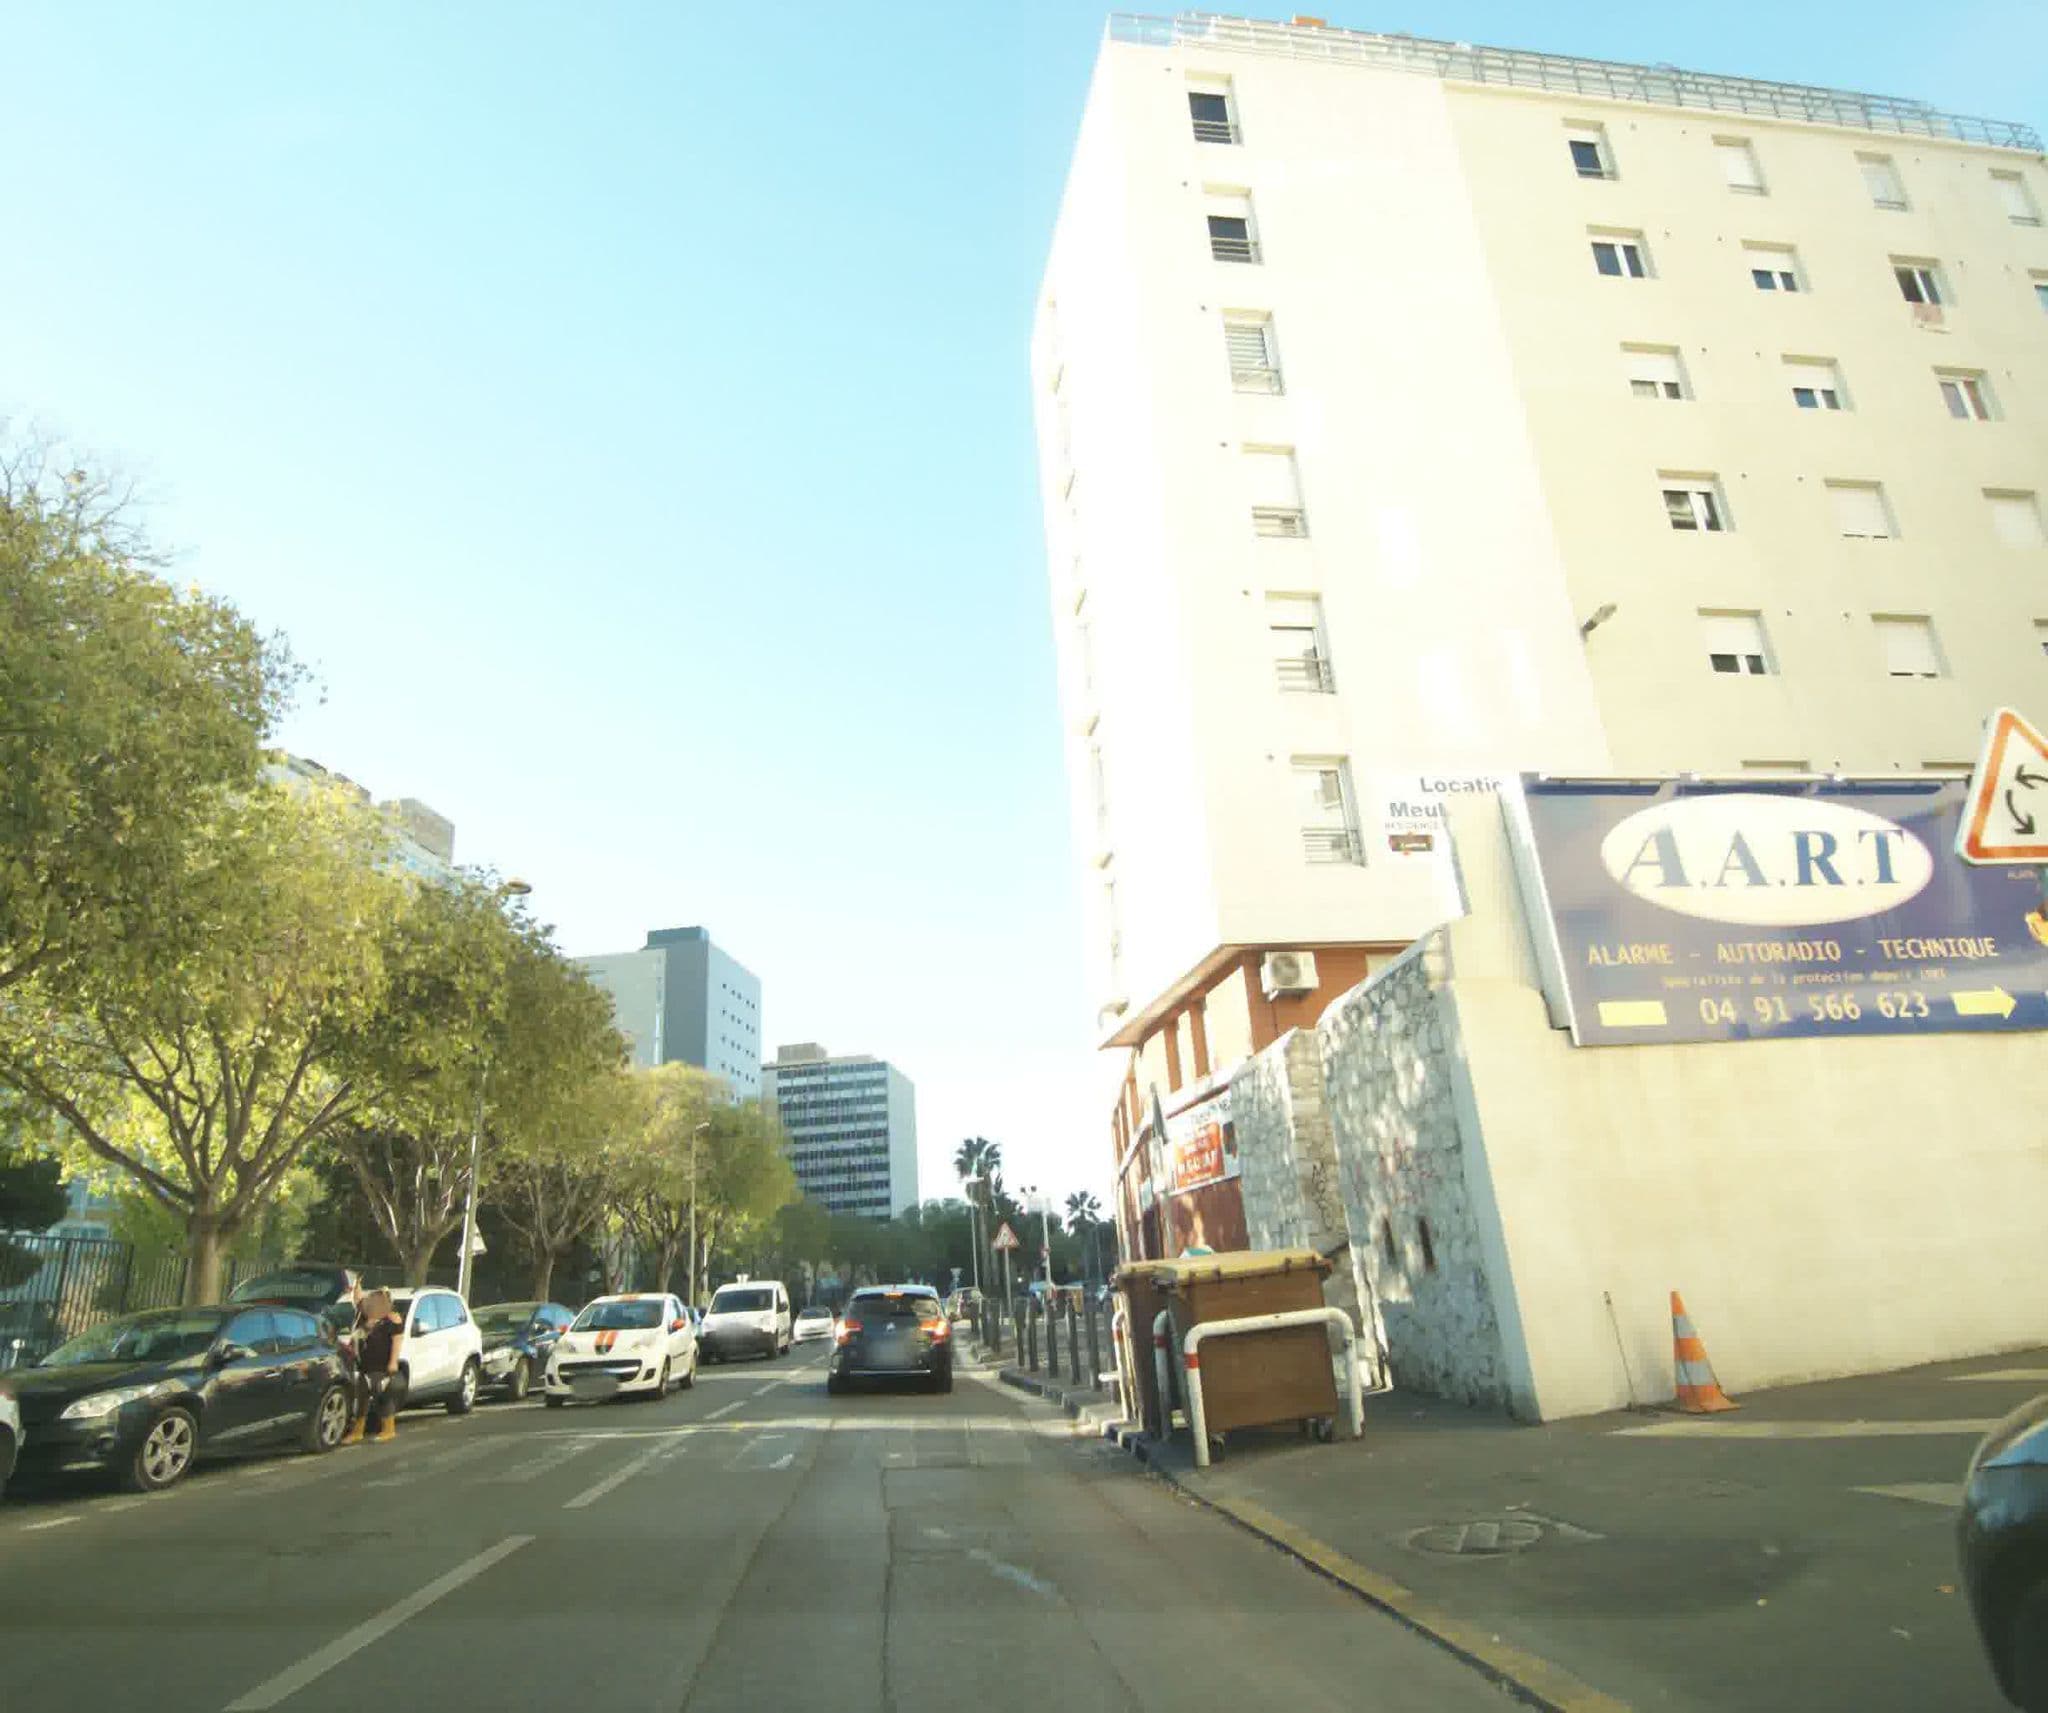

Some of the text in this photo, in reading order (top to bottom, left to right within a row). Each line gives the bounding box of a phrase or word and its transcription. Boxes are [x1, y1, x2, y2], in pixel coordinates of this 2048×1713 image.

[1622, 824, 1905, 888] A.A.R.T
[1588, 943, 1674, 965] ALARME
[1717, 940, 1841, 963] AUTORADIO
[1877, 937, 2000, 959] TECHNIQUE
[1699, 990, 1930, 1025] 04 91 566 623
